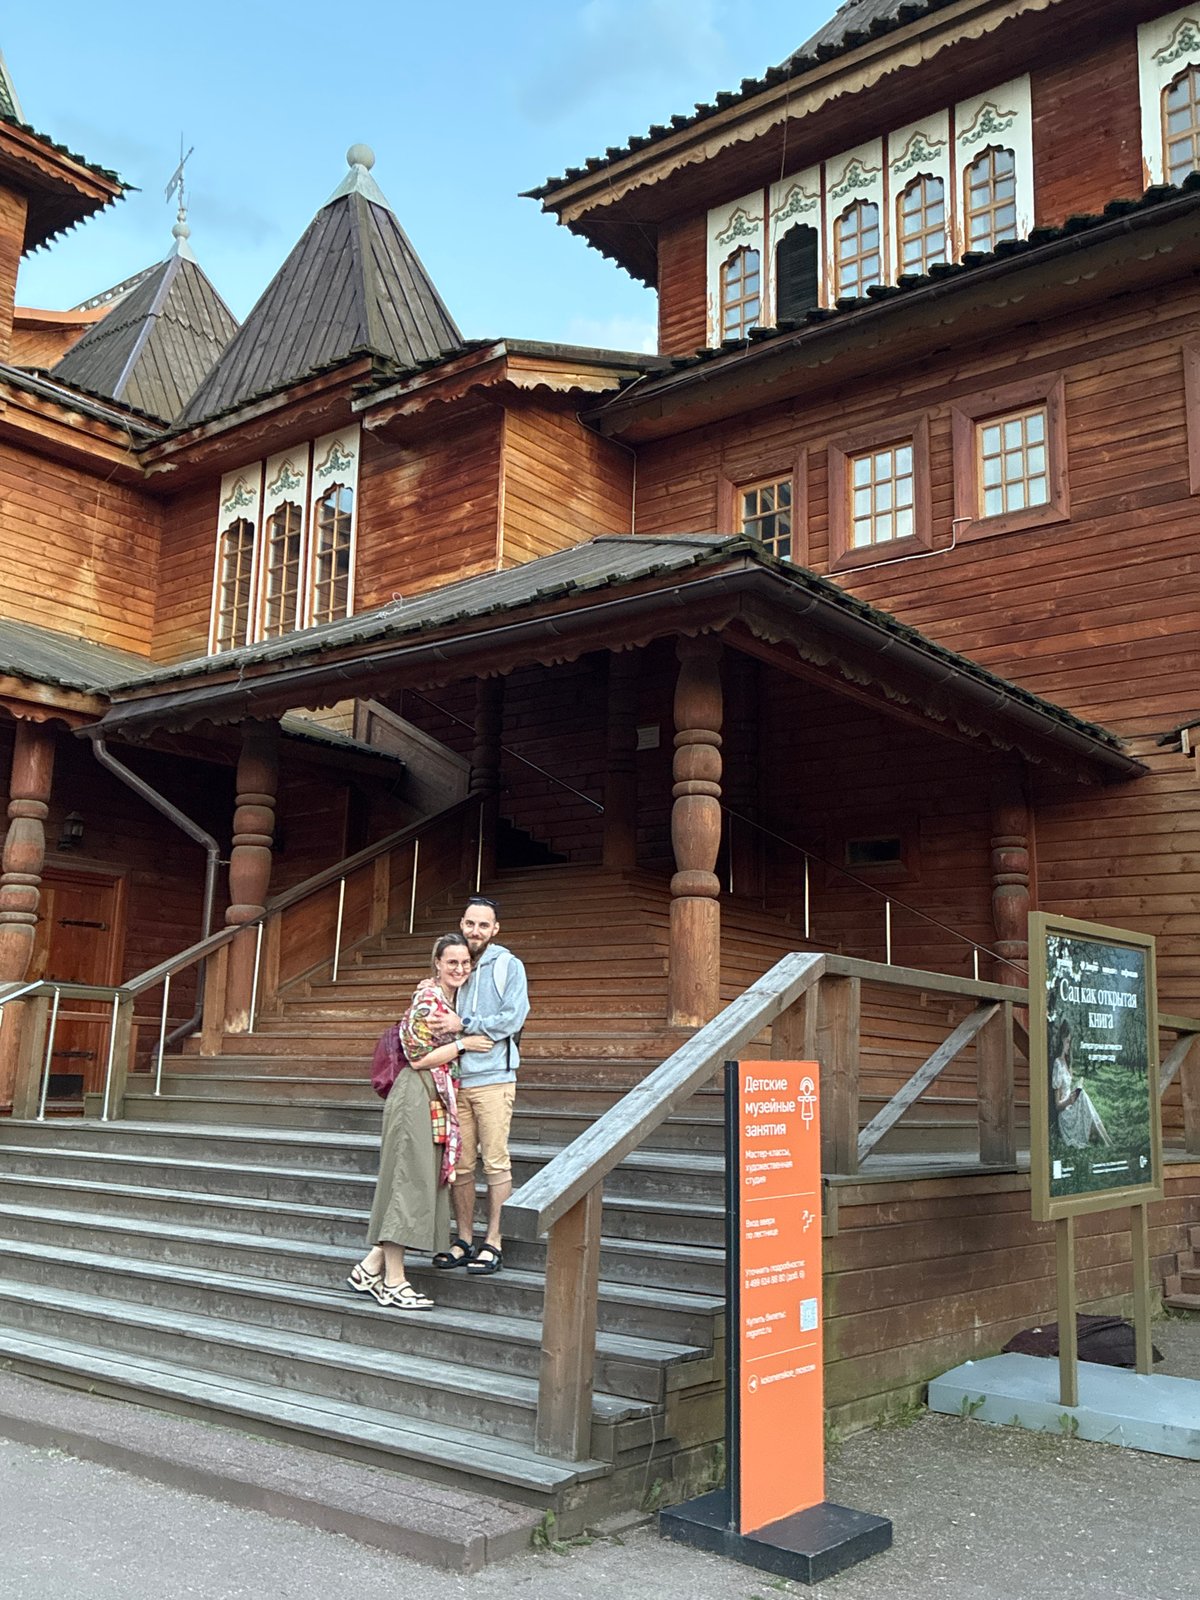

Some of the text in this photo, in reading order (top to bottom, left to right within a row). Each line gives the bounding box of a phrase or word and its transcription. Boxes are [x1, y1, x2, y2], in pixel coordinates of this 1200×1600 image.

[1060, 978, 1137, 1011] Сад как открытая
[1088, 1012, 1114, 1029] книга
[744, 1076, 788, 1093] Детские
[745, 1098, 796, 1118] музейные
[745, 1123, 787, 1137] занятия
[745, 1148, 791, 1159] Мастер-классы,
[745, 1161, 793, 1172] художественная
[745, 1176, 767, 1186] студия
